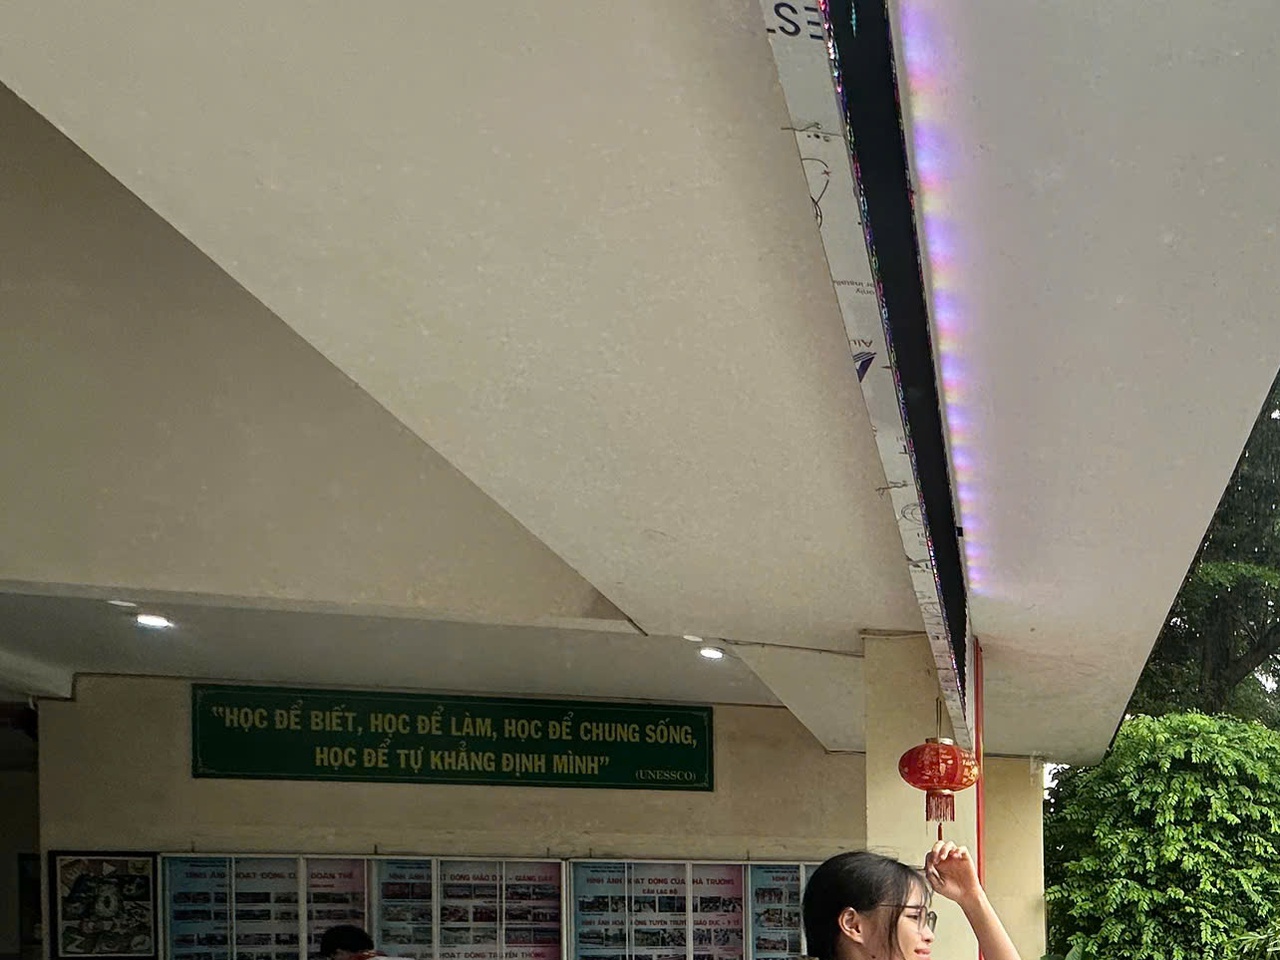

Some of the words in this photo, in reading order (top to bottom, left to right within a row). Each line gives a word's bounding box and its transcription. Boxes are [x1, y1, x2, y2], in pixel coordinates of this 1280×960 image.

[274, 699, 304, 730] ĐỂ
[310, 703, 363, 736] BIẾT,
[369, 712, 410, 737] HỌC
[417, 705, 445, 735] ĐỂ
[450, 711, 497, 741] LÀM,
[504, 718, 542, 742] HỌC
[548, 710, 574, 740] ĐỂ
[580, 721, 640, 743] CHUNG
[645, 716, 698, 748] SỐNG,
[314, 746, 357, 771] HỌC
[362, 732, 394, 769] ĐỂ
[396, 745, 424, 774] TỰ
[501, 751, 546, 778] ĐỊNH
[635, 768, 696, 783] (UNESSCO)
